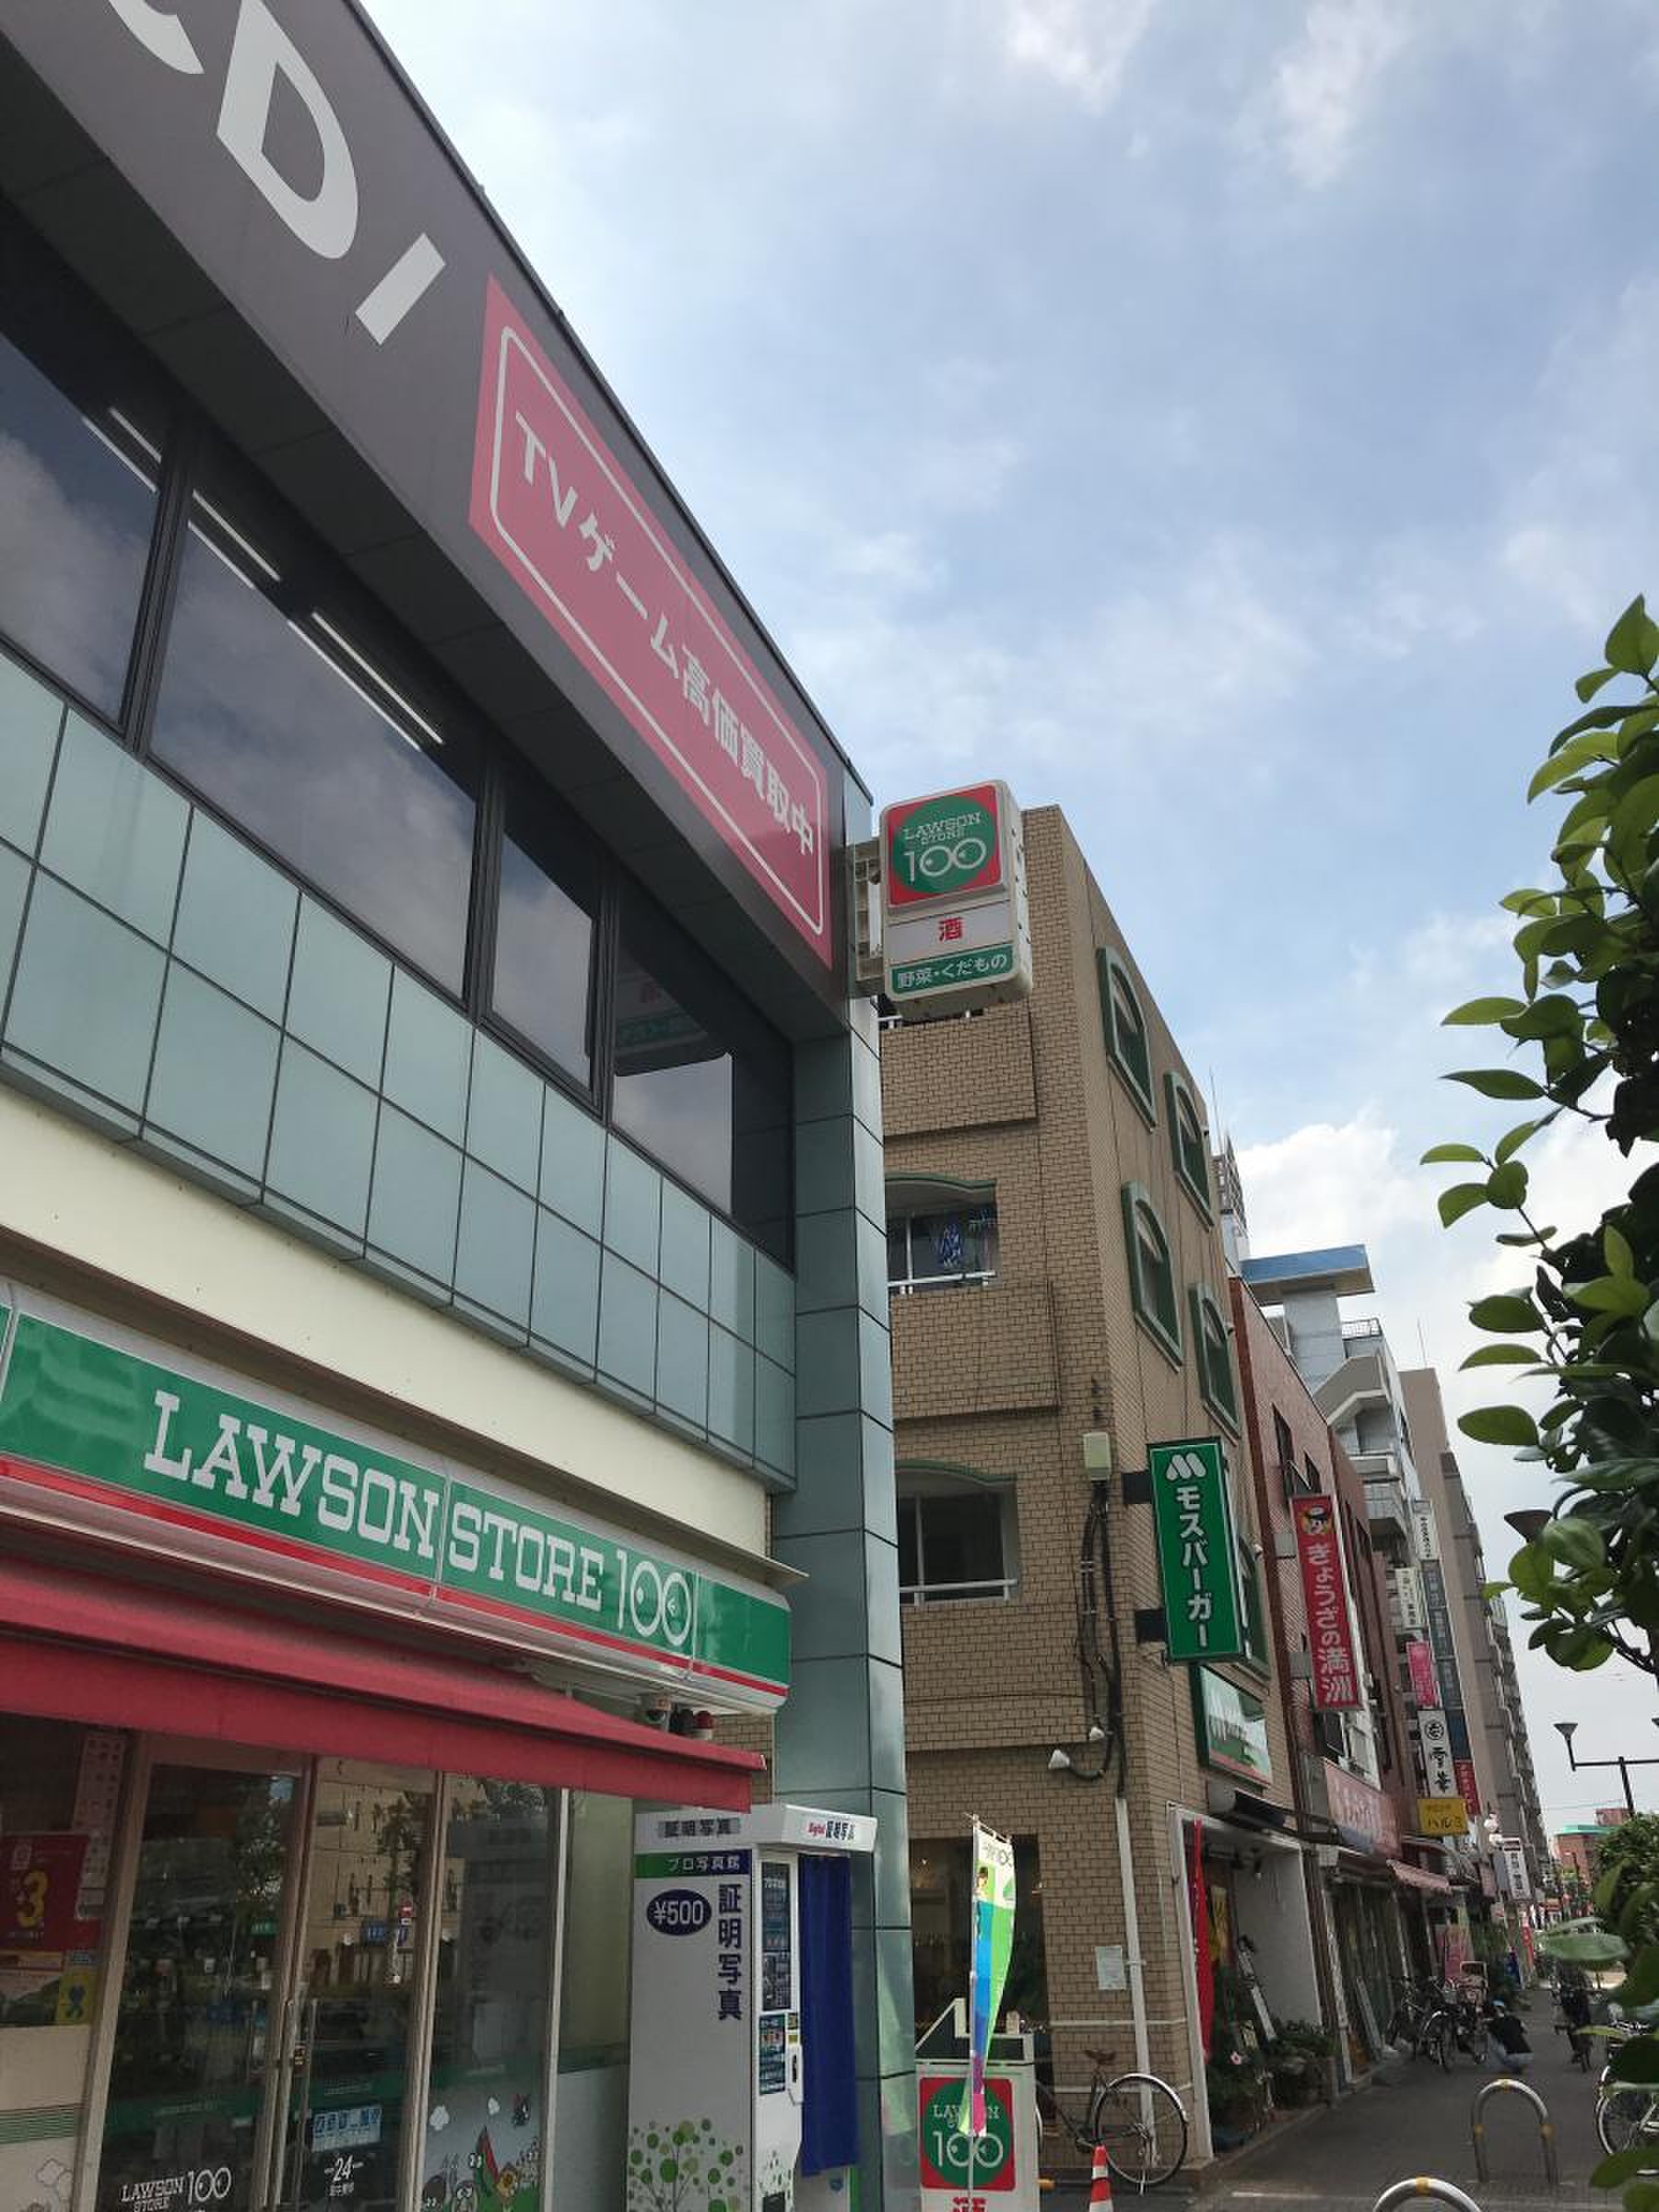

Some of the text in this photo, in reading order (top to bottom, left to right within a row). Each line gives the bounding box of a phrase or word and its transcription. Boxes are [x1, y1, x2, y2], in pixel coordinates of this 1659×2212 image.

[515, 410, 816, 857] TVゲーム高価買取中
[903, 811, 982, 841] LAWSON
[903, 838, 987, 883] 100
[938, 917, 964, 941] 酒
[143, 1389, 693, 1647] LAWSON STORE 100
[1175, 1486, 1214, 1649] モスバーガー
[653, 1900, 704, 1926] ¥500
[718, 1883, 743, 2021] 証明写真
